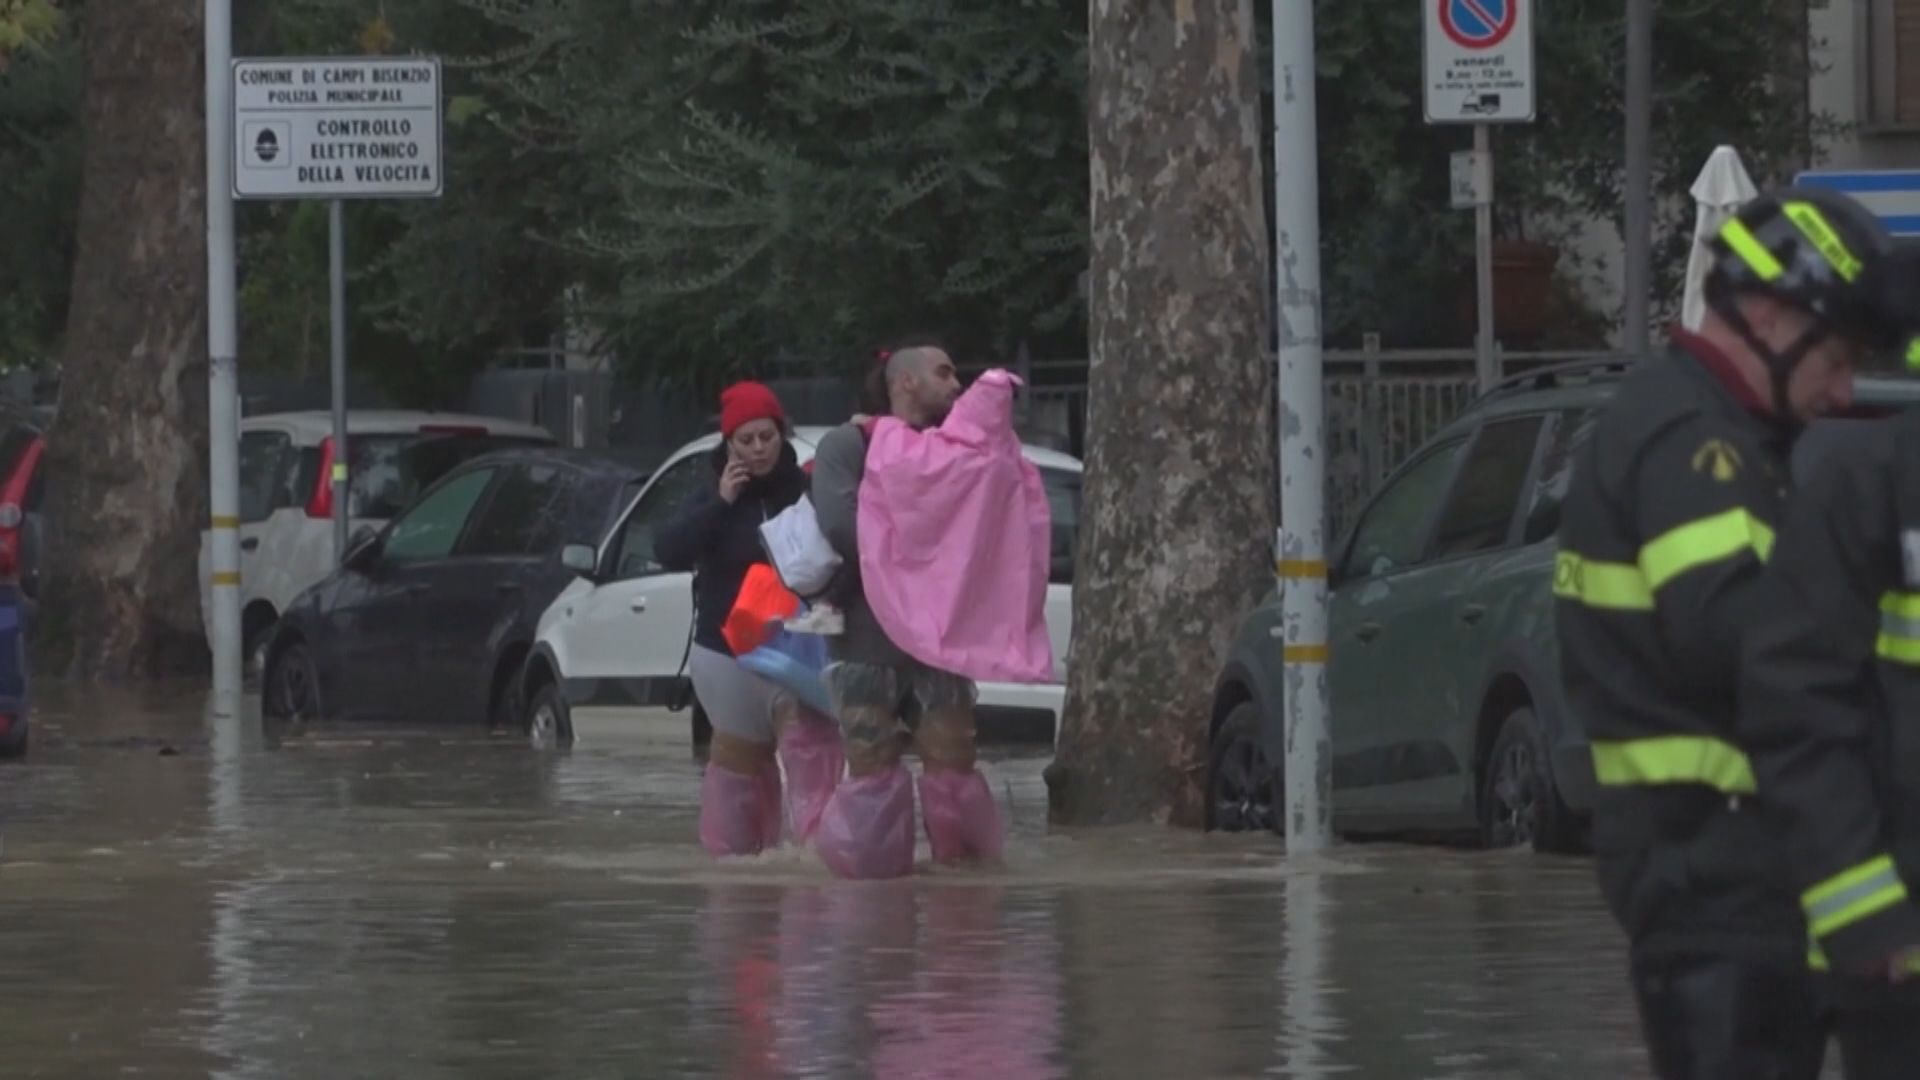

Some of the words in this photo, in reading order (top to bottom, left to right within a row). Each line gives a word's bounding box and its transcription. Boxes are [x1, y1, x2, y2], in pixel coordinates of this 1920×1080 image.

[240, 69, 293, 85] COMUNE
[302, 68, 316, 84] DI
[323, 68, 365, 84] CAMPI
[372, 67, 431, 83] BISENZIO
[268, 90, 318, 103] POLIZIA
[327, 89, 403, 103] MUNICIPALE
[317, 119, 411, 136] CONTROLLO
[310, 143, 418, 160] ELETTRONICO
[298, 166, 344, 183] DELLA
[354, 165, 431, 182] VELOCITA
